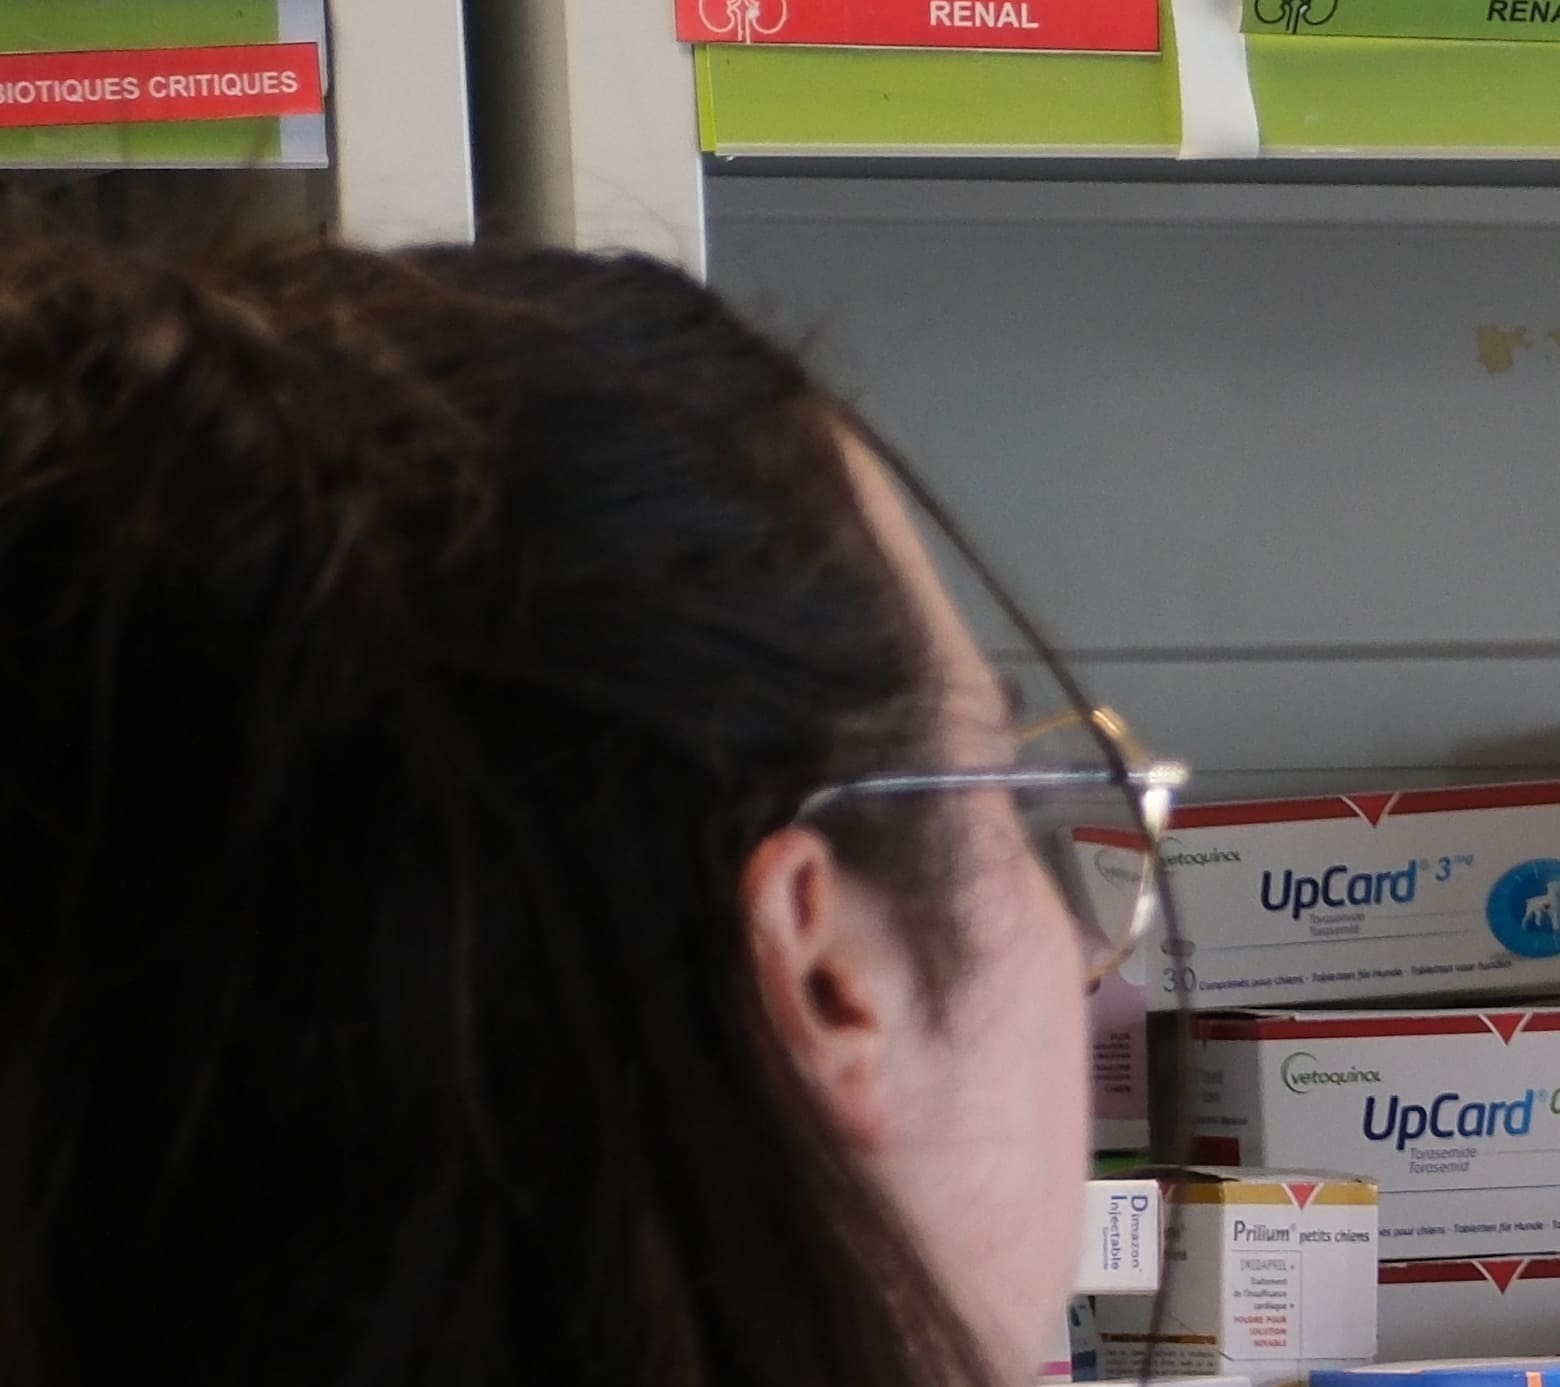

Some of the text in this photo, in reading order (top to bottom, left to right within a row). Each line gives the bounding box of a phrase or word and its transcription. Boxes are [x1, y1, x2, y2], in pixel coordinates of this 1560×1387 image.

[928, 0, 1039, 30] RENAL
[149, 69, 299, 99] CRITIQUES
[1260, 856, 1453, 920] UpCard 3
[1362, 1088, 1536, 1151] UpCard
[1107, 1193, 1129, 1272] Injectable
